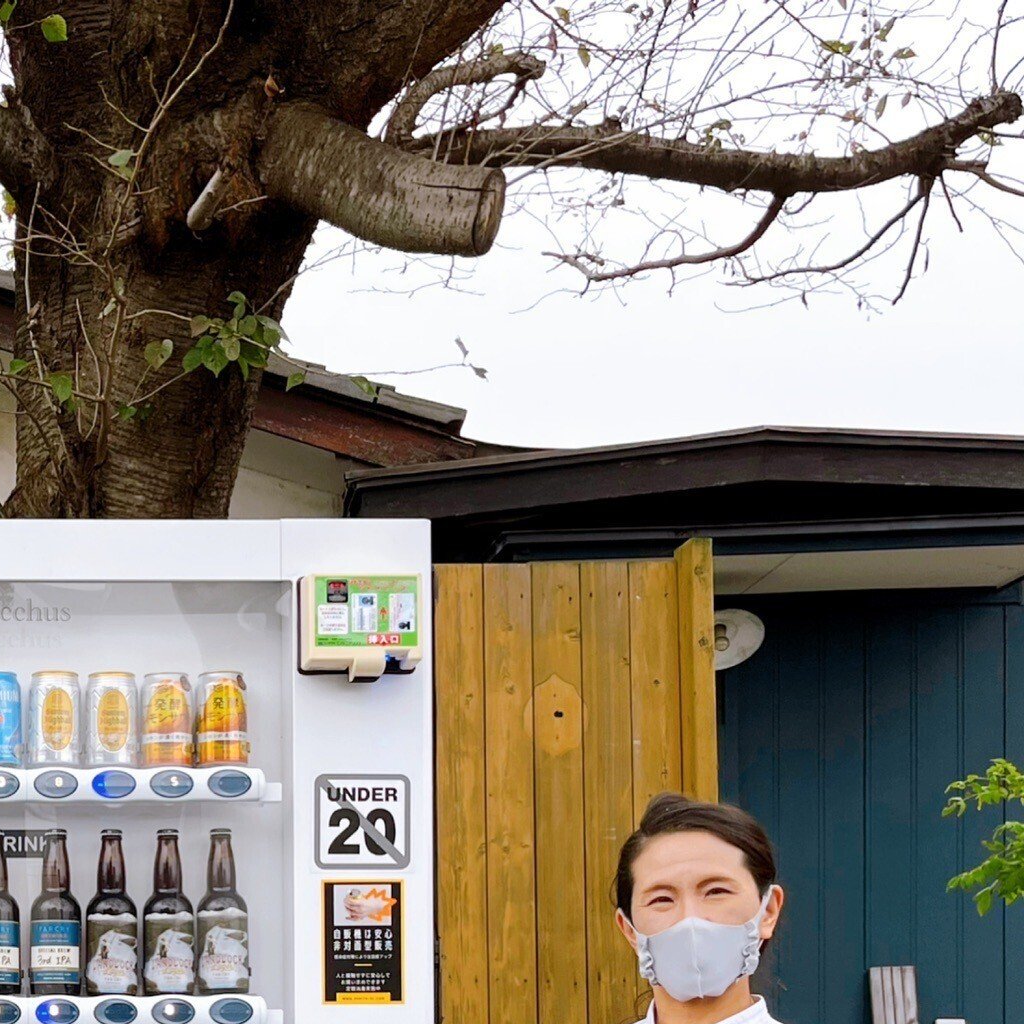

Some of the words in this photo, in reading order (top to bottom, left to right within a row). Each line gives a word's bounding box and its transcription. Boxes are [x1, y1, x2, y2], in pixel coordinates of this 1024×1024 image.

[327, 787, 398, 801] UNDER
[328, 808, 396, 855] 20
[56, 956, 71, 965] IPA
